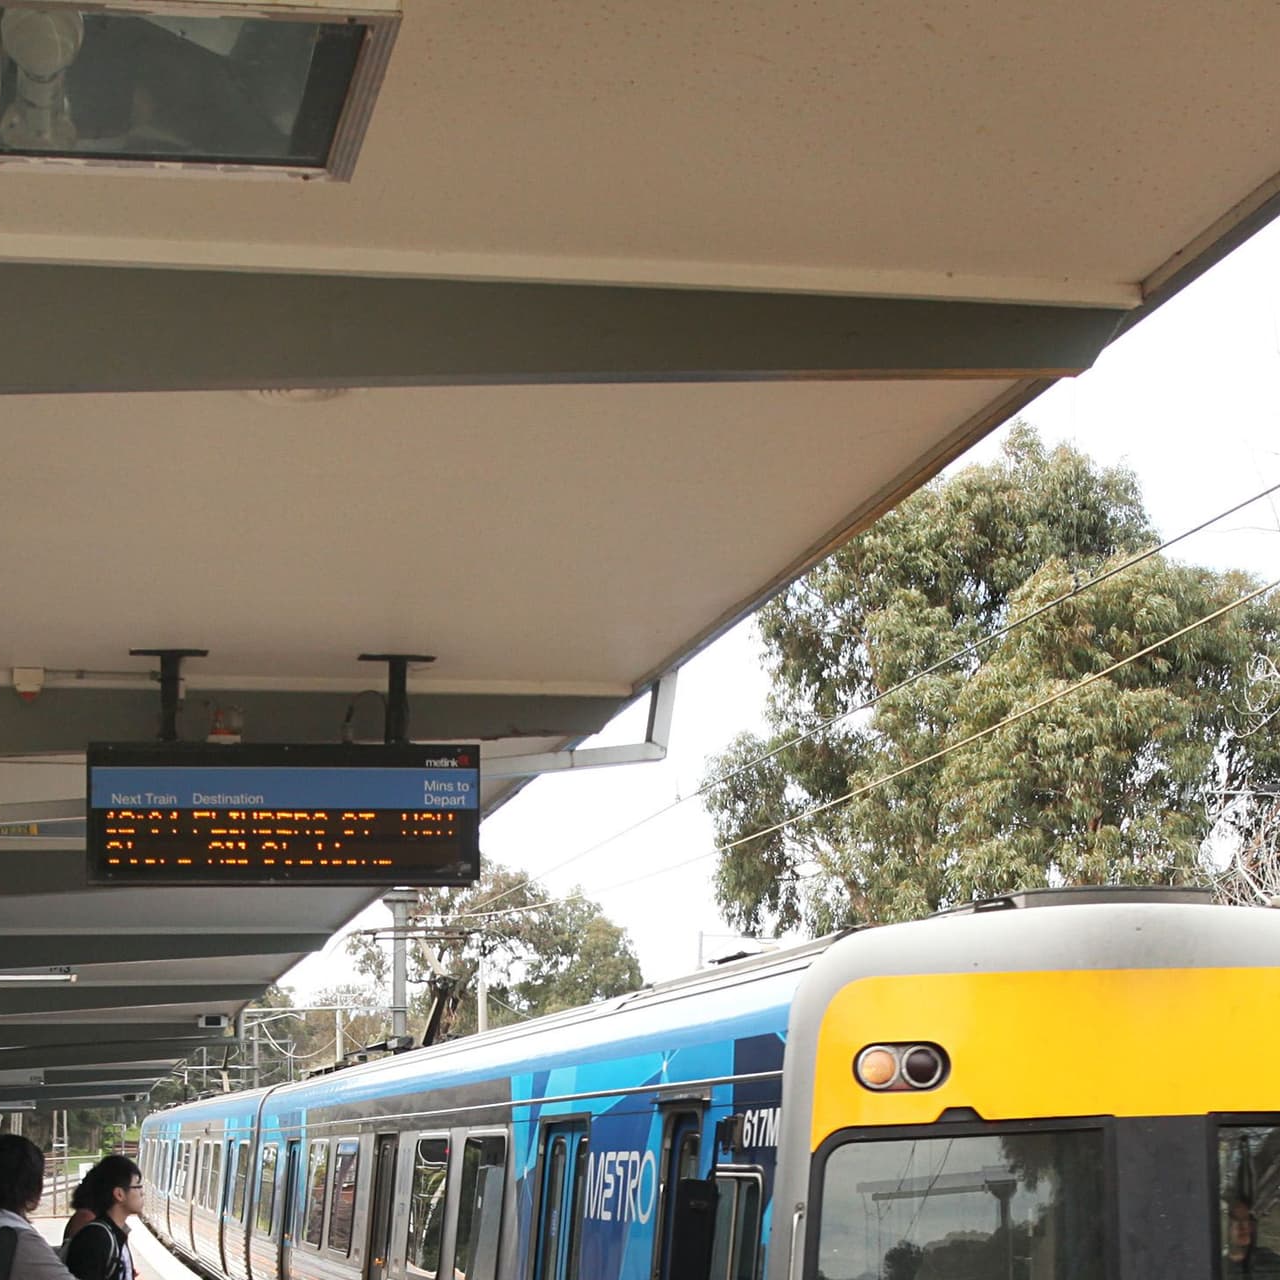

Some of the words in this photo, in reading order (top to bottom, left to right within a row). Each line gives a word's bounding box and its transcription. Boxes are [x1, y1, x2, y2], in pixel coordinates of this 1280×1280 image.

[425, 756, 459, 768] metlink
[424, 780, 452, 793] Mins
[456, 781, 470, 793] to
[111, 794, 142, 805] Next
[145, 793, 178, 805] Train
[192, 793, 264, 805] Destination
[424, 793, 466, 807] Depart
[743, 1107, 781, 1148] 617M
[584, 1150, 657, 1225] METRO
